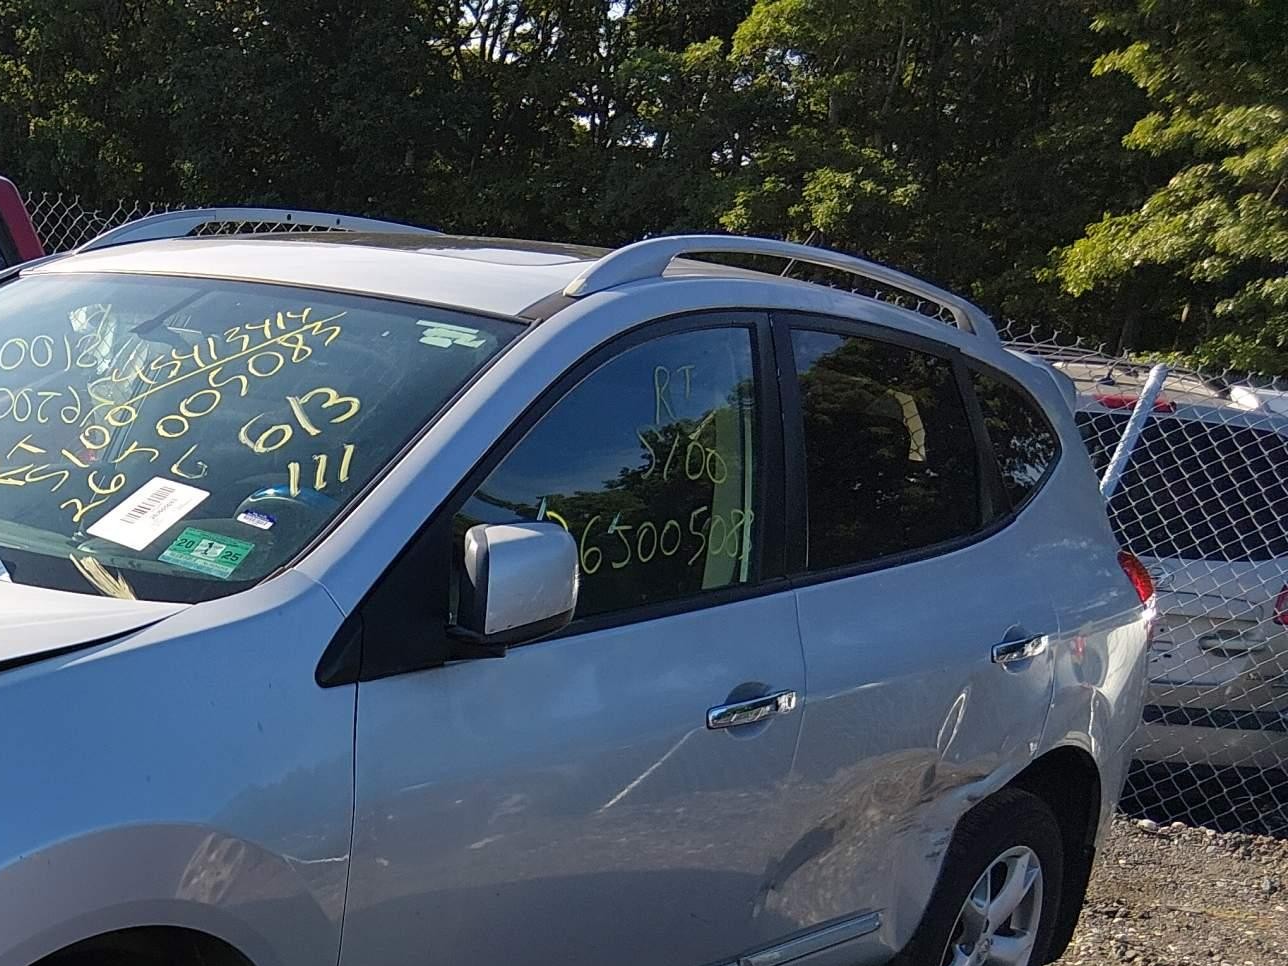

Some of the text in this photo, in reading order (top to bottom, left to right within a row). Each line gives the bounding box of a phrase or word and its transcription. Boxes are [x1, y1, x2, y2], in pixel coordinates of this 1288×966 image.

[654, 365, 696, 424] RT
[176, 538, 195, 549] 20
[220, 550, 240, 562] 25
